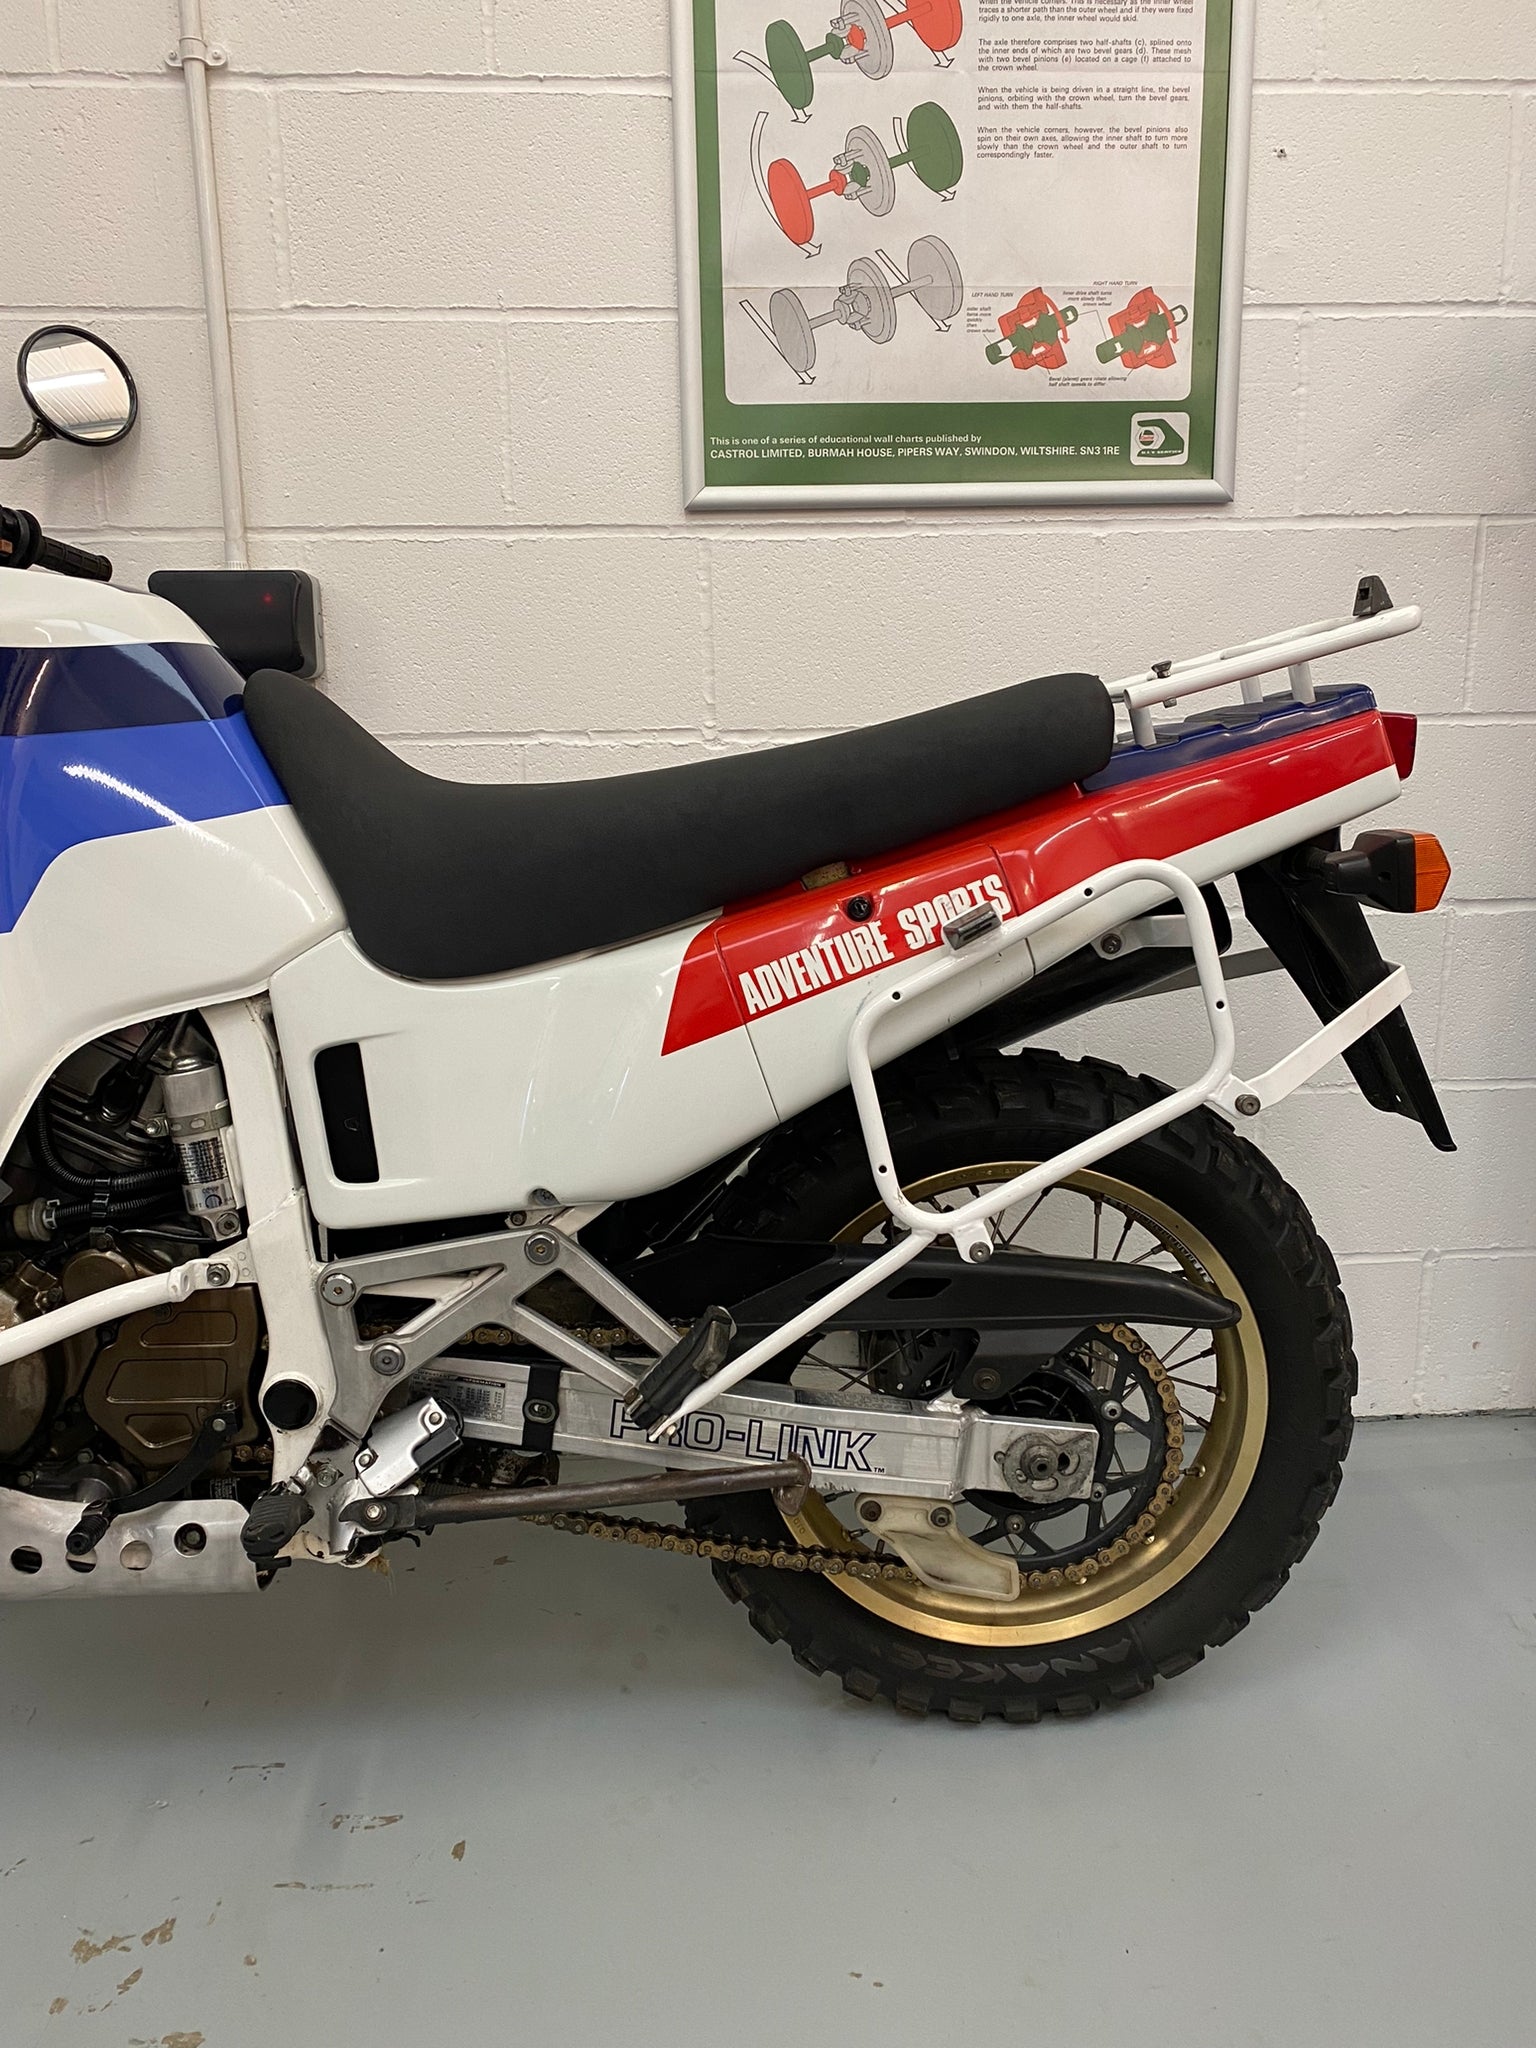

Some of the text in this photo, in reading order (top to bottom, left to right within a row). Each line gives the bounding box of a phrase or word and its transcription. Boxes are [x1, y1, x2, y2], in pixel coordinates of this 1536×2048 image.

[1032, 6, 1048, 14] path
[1141, 6, 1156, 14] they
[978, 14, 1000, 23] rigidly
[1043, 39, 1077, 47] comprises
[1149, 39, 1173, 47] splined
[1033, 55, 1058, 64] pinions
[1050, 86, 1069, 94] being
[1111, 86, 1139, 94] straight
[1007, 94, 1033, 103] orbiting
[1146, 126, 1170, 134] pinions
[977, 134, 991, 143] spin
[1060, 134, 1089, 143] allowing
[976, 142, 998, 151] slowly
[976, 151, 1030, 159] correspondingly
[925, 434, 981, 443] published
[970, 434, 981, 442] by
[710, 449, 758, 458] CASTROL
[761, 449, 804, 457] LIMITED,
[808, 448, 854, 456] BURMAH
[856, 448, 894, 456] HOUSE,
[897, 447, 932, 455] PIPERS
[934, 447, 961, 455] WAY,
[964, 447, 1017, 455] SWINDON,
[738, 920, 895, 1015] ADVENTURE
